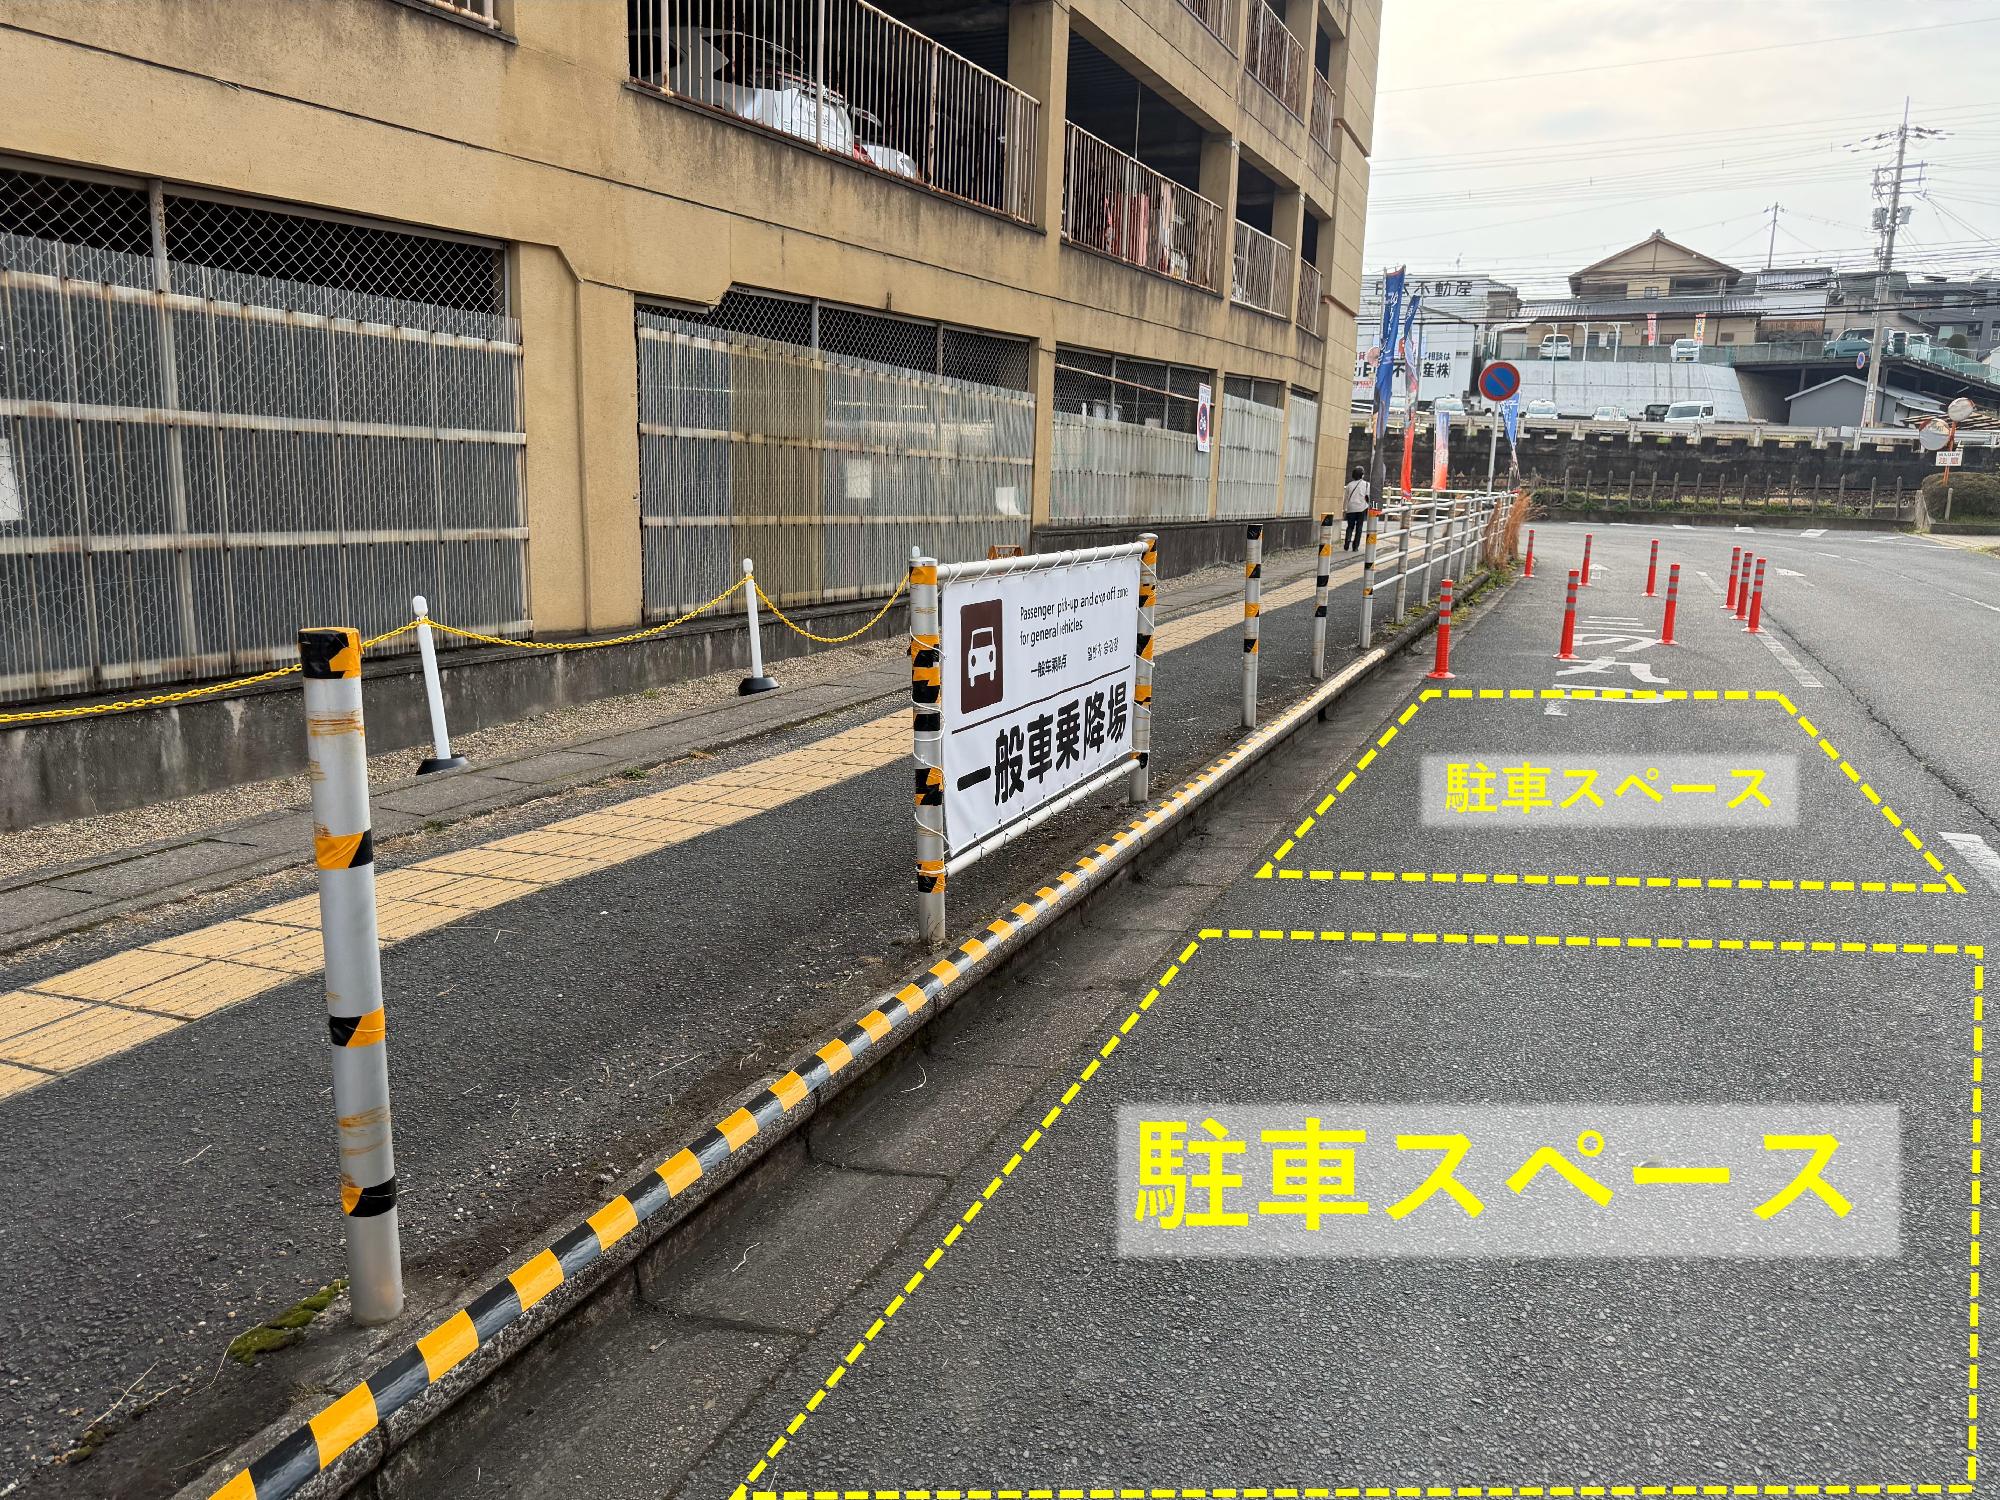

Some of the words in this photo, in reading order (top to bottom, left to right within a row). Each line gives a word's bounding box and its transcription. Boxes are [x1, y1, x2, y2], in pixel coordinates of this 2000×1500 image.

[1020, 603, 1055, 621] Passenger
[1080, 591, 1094, 608] and
[1020, 630, 1030, 646] for
[1030, 622, 1059, 647] general
[1059, 618, 1083, 636] vehicles
[957, 681, 1128, 806] 一般車乗降場
